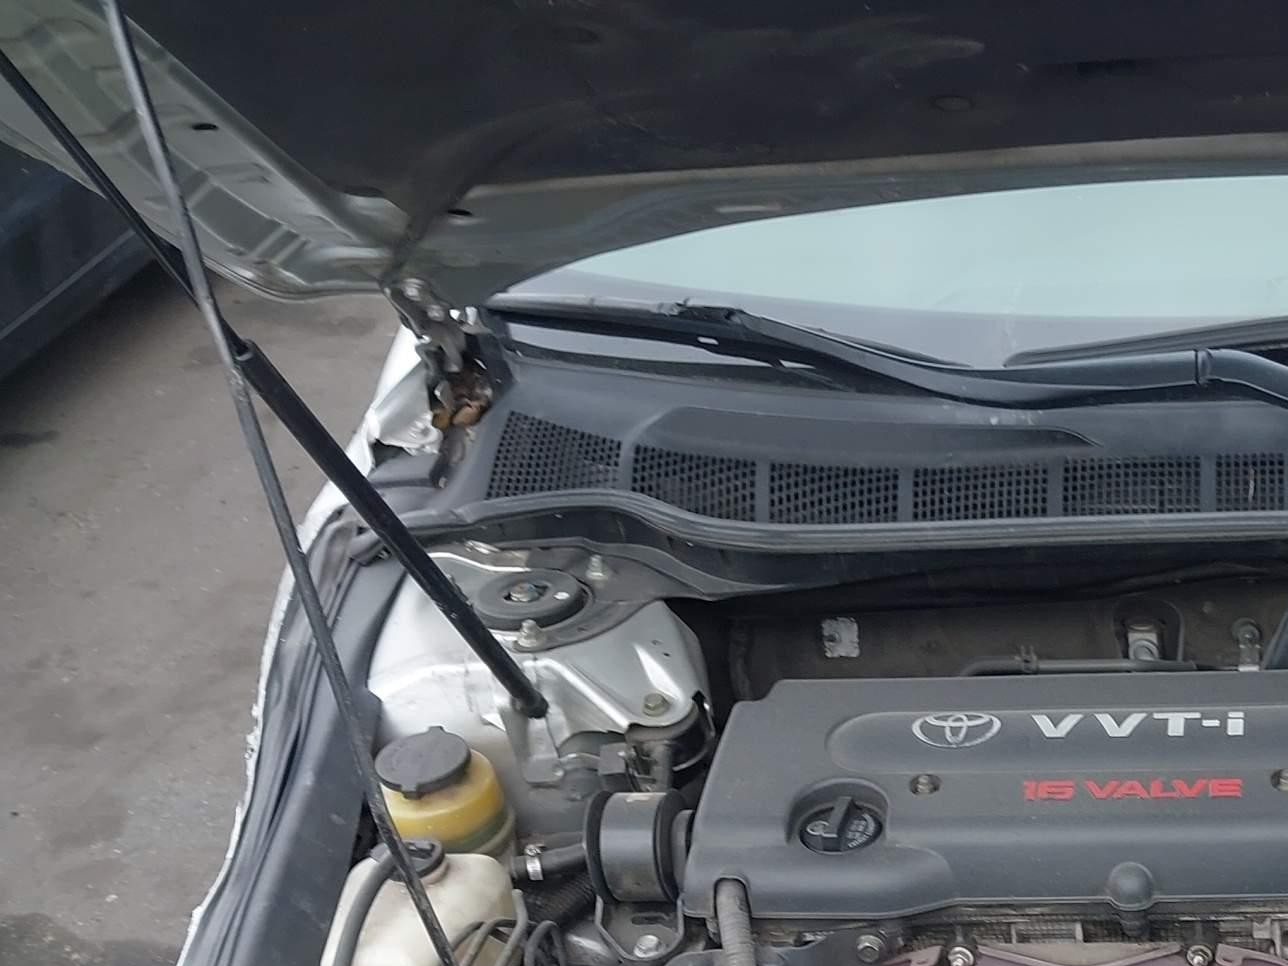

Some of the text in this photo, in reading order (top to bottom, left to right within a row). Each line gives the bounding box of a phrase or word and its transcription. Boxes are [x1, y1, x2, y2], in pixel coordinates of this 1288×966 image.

[1031, 711, 1246, 738] VVT-i
[1024, 778, 1244, 801] 16 VALVE
